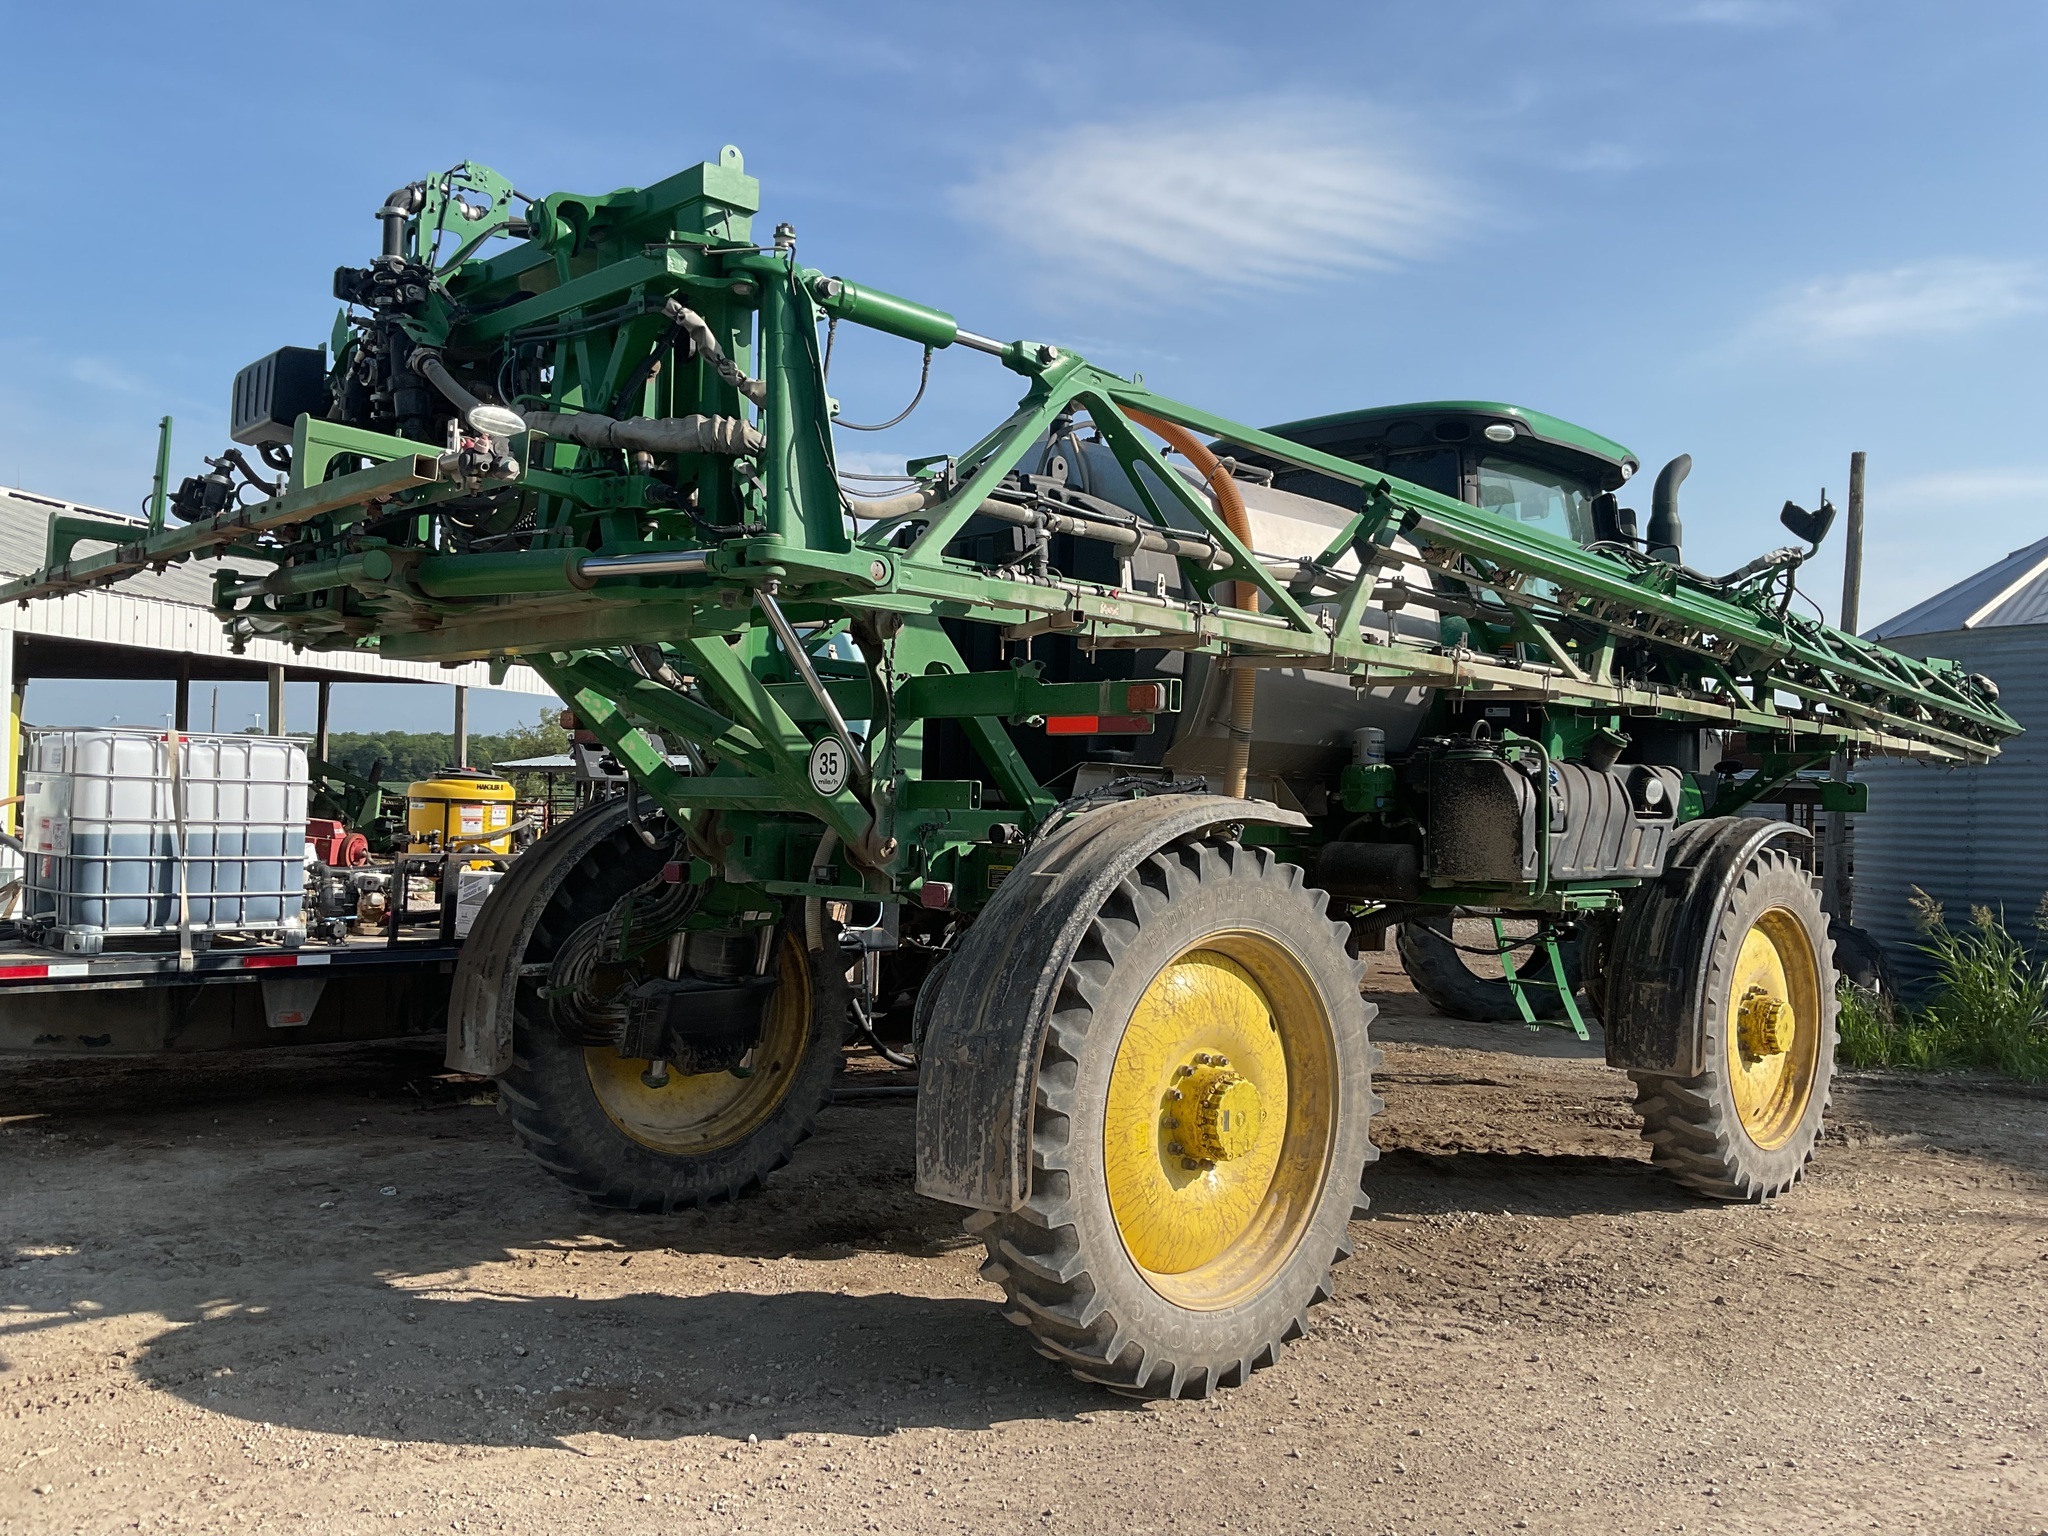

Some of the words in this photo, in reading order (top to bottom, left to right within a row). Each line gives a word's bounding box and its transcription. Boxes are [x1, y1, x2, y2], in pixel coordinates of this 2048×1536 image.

[819, 752, 837, 775] 35
[1145, 893, 1206, 951] RADIAL
[1215, 885, 1245, 904] ALL
[1253, 885, 1323, 946] TRACTION
